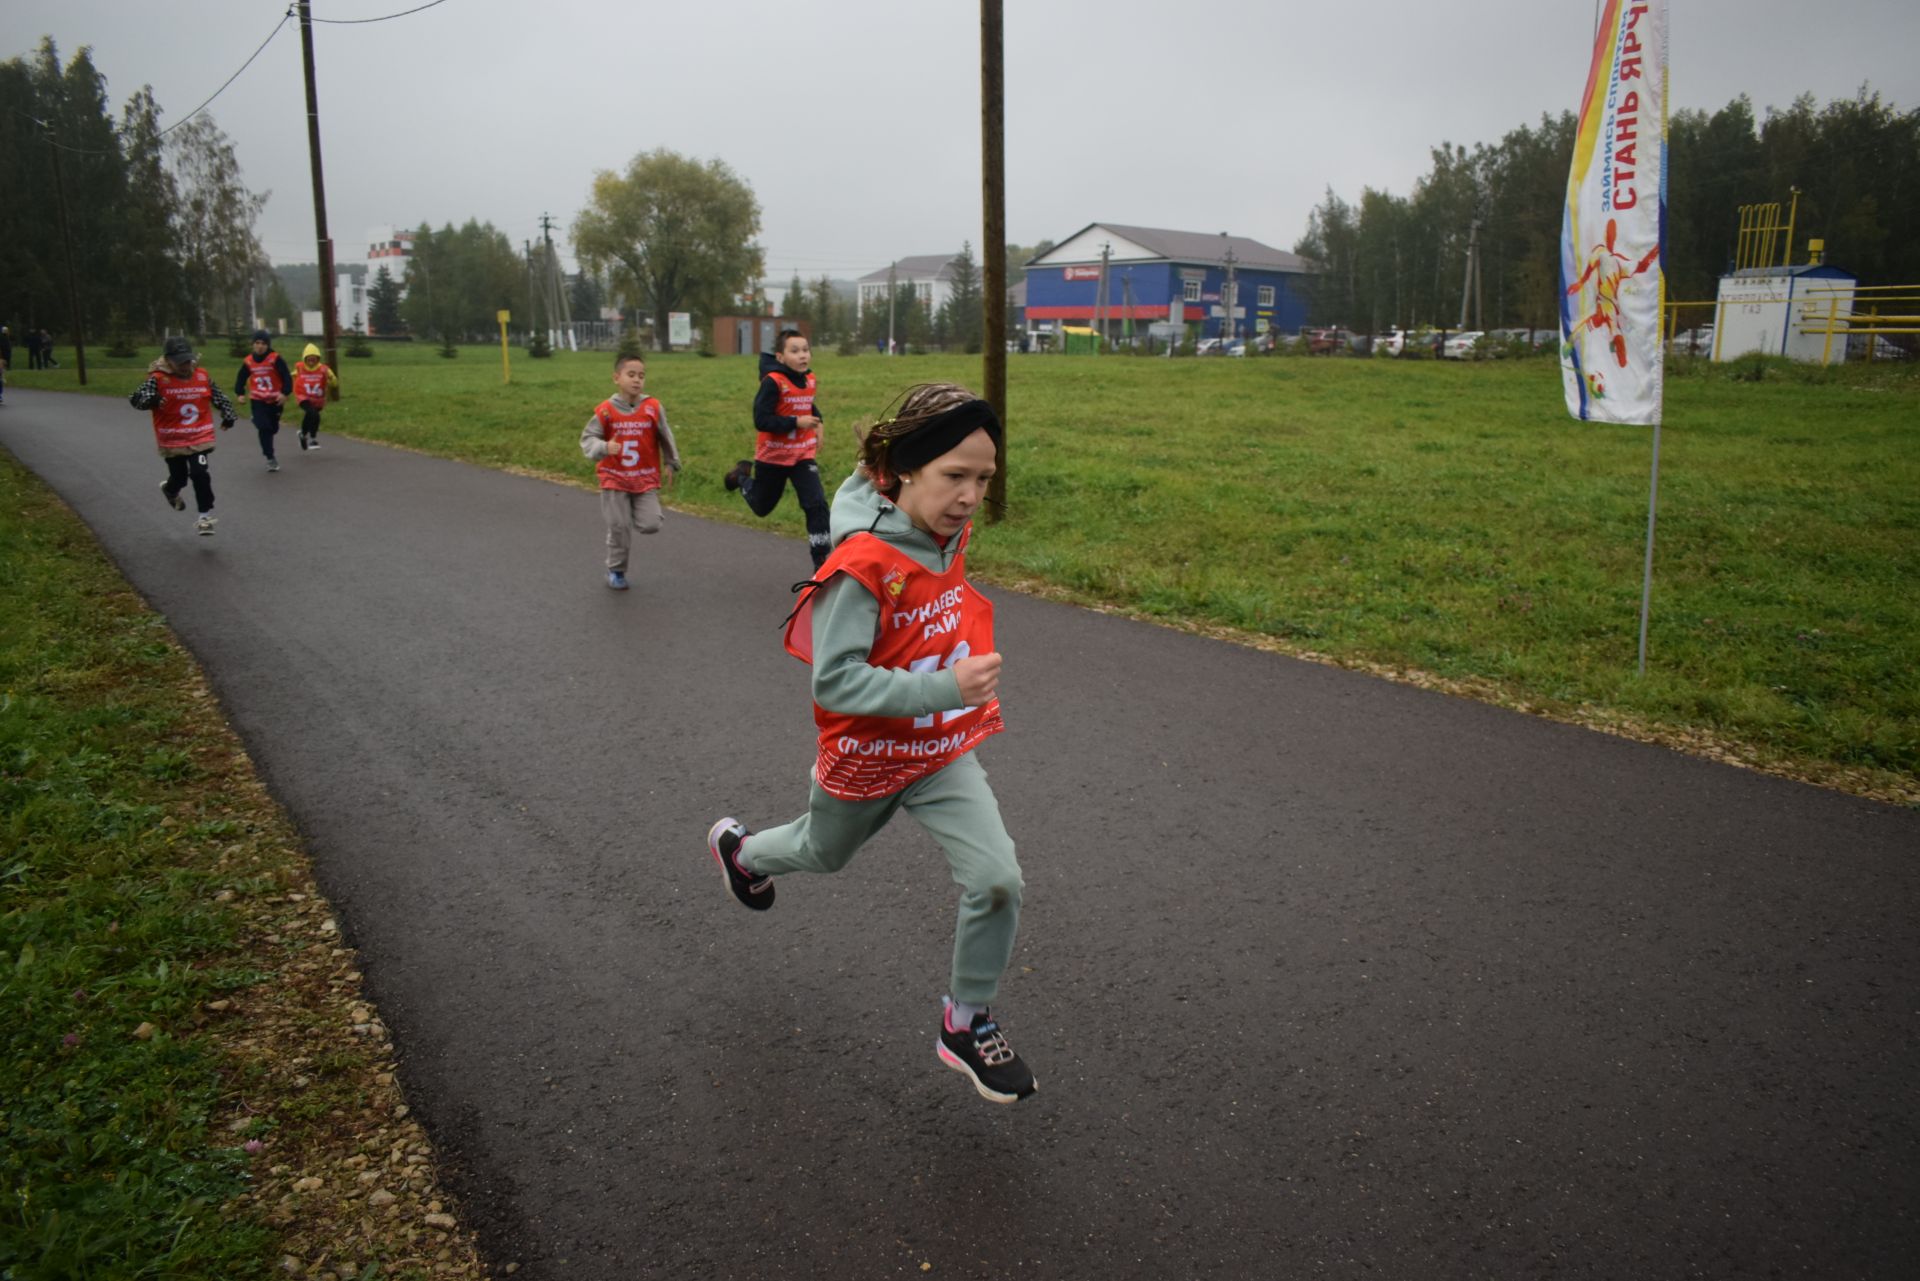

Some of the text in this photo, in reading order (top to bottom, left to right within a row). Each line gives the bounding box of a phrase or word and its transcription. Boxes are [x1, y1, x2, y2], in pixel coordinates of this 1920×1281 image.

[1613, 0, 1649, 211] СТАНЬ ЯРЧ
[1602, 114, 1616, 213] ЗАЙМИСЬ
[1742, 304, 1761, 314] ГАЗ
[179, 403, 200, 425] 9
[621, 440, 640, 467] 5
[893, 584, 964, 629] ТУКАЕВС
[837, 731, 966, 757] СПОРТ НОРМ
